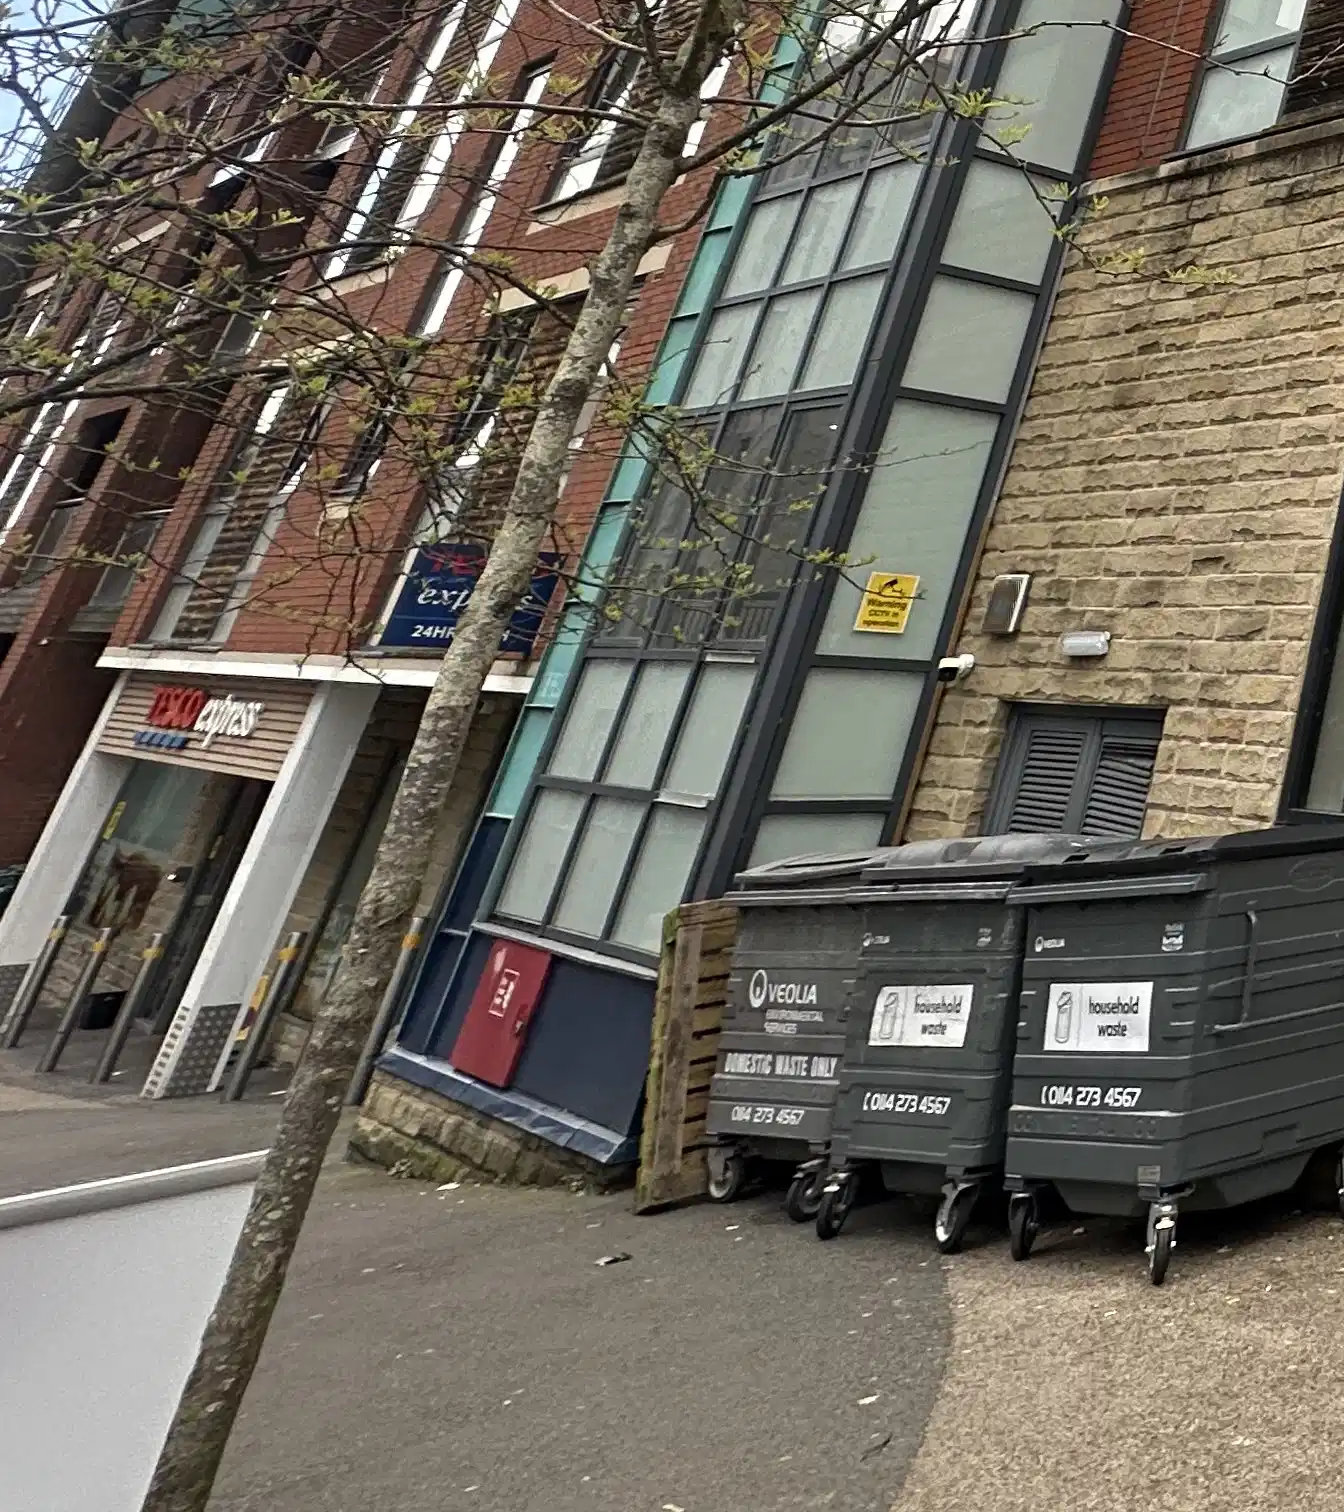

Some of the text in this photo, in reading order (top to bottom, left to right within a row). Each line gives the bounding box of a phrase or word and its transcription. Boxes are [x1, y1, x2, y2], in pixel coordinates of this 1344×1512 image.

[767, 984, 817, 1004] VEOLIA
[914, 995, 962, 1014] household
[1089, 996, 1139, 1015] household
[921, 1021, 947, 1035] waste
[1098, 1022, 1127, 1037] waste
[725, 1052, 837, 1077] DOMESTIC WASTE ONLY
[895, 1094, 918, 1112] 273
[919, 1096, 951, 1115] 4567
[1075, 1087, 1100, 1106] 273
[1104, 1088, 1142, 1107] 4567
[753, 1107, 774, 1123] 273
[776, 1108, 804, 1125] 4567
